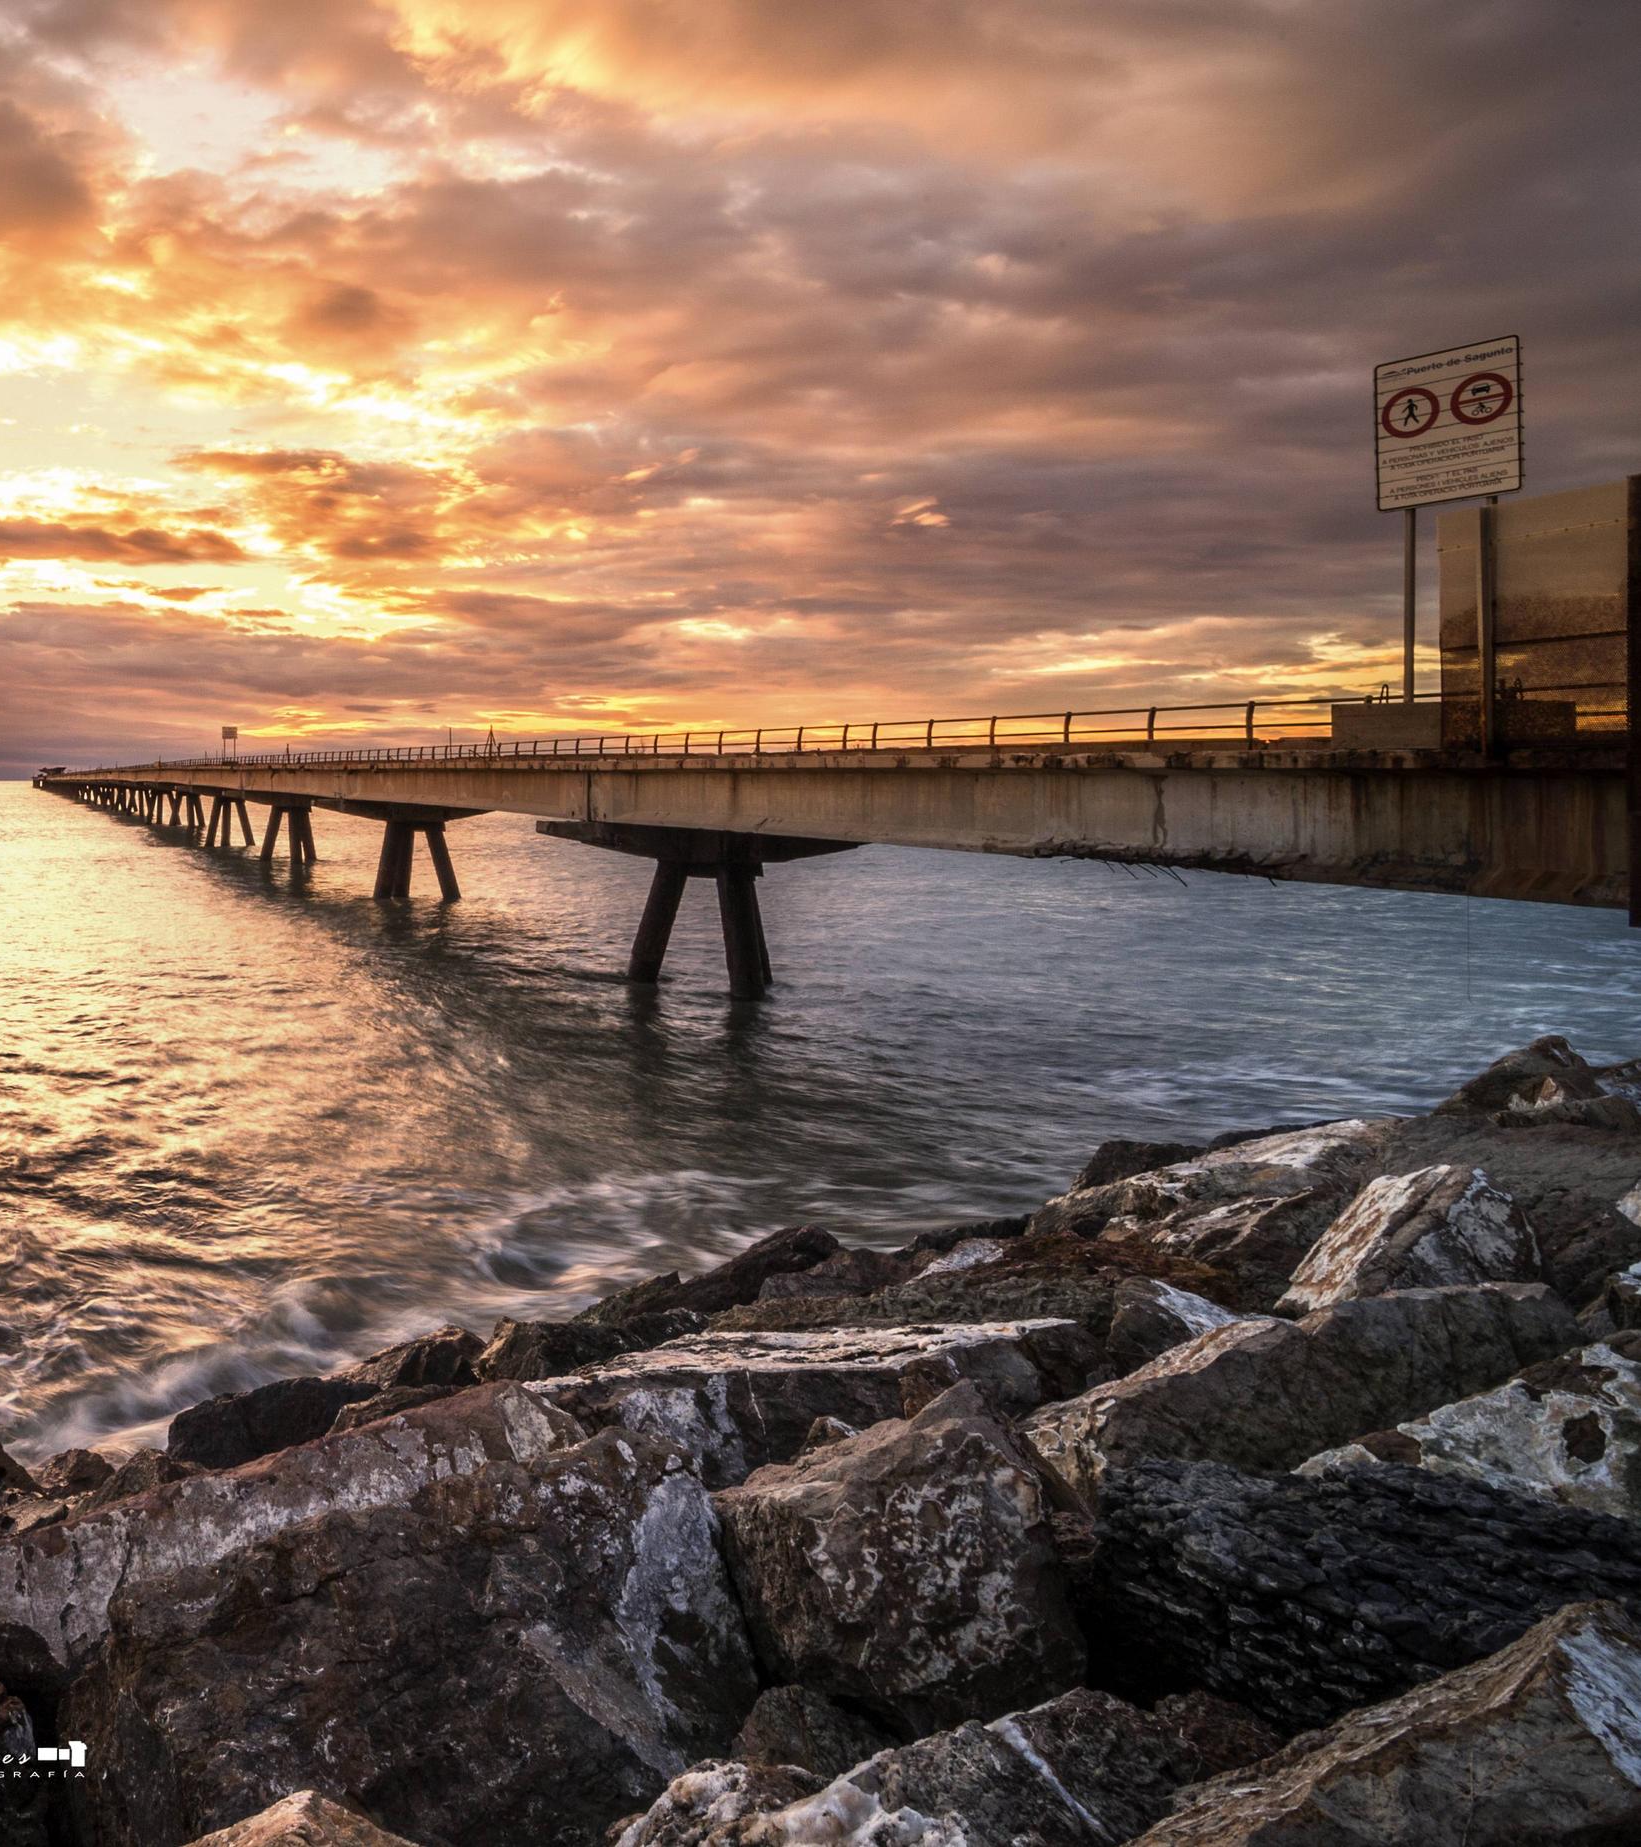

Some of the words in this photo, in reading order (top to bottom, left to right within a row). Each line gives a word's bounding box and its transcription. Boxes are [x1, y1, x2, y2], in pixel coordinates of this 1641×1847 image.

[1406, 361, 1443, 375] Puerto
[1447, 358, 1460, 367] de
[1464, 346, 1513, 364] Sagunto
